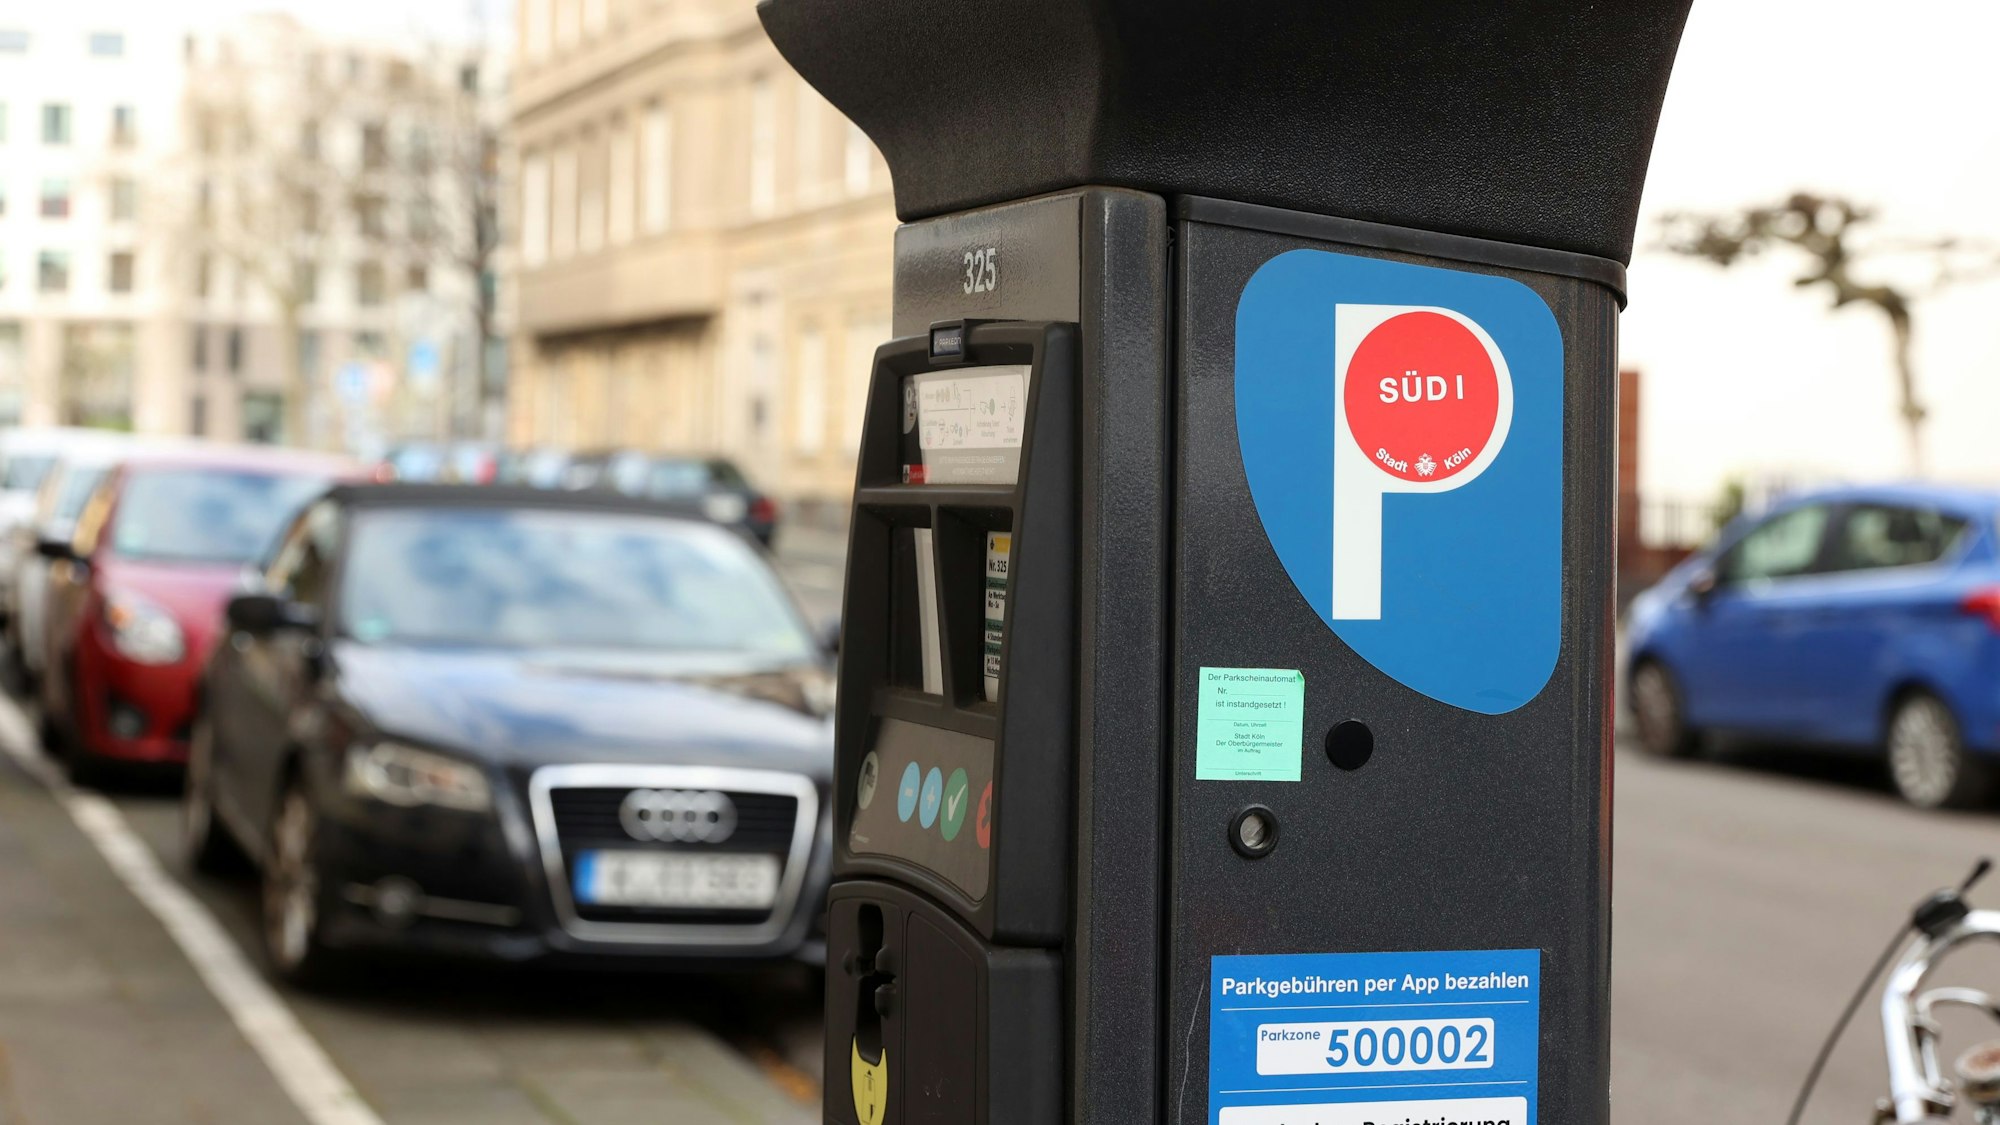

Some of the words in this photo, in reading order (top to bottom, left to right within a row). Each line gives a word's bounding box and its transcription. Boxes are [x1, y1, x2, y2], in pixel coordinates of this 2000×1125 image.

[964, 248, 996, 294] 325
[1379, 370, 1448, 404] SÜD
[1332, 303, 1514, 621] P
[1375, 447, 1409, 473] Stadt
[1443, 447, 1472, 470] Köln
[988, 559, 996, 572] Nr.
[997, 560, 1007, 573] 325
[1207, 673, 1221, 681] Der
[1223, 673, 1296, 683] Parkscheinautomat
[1217, 687, 1228, 695] Nr.
[1226, 700, 1282, 710] instandgesetzt
[1227, 740, 1283, 748] Oberbürgermeister
[1221, 976, 1359, 998] Parkgebühren
[1364, 977, 1397, 996] per
[1401, 973, 1440, 994] App
[1445, 971, 1529, 990] bezahlen
[1260, 1029, 1321, 1042] Parkzone
[1325, 1024, 1488, 1068] 500002
